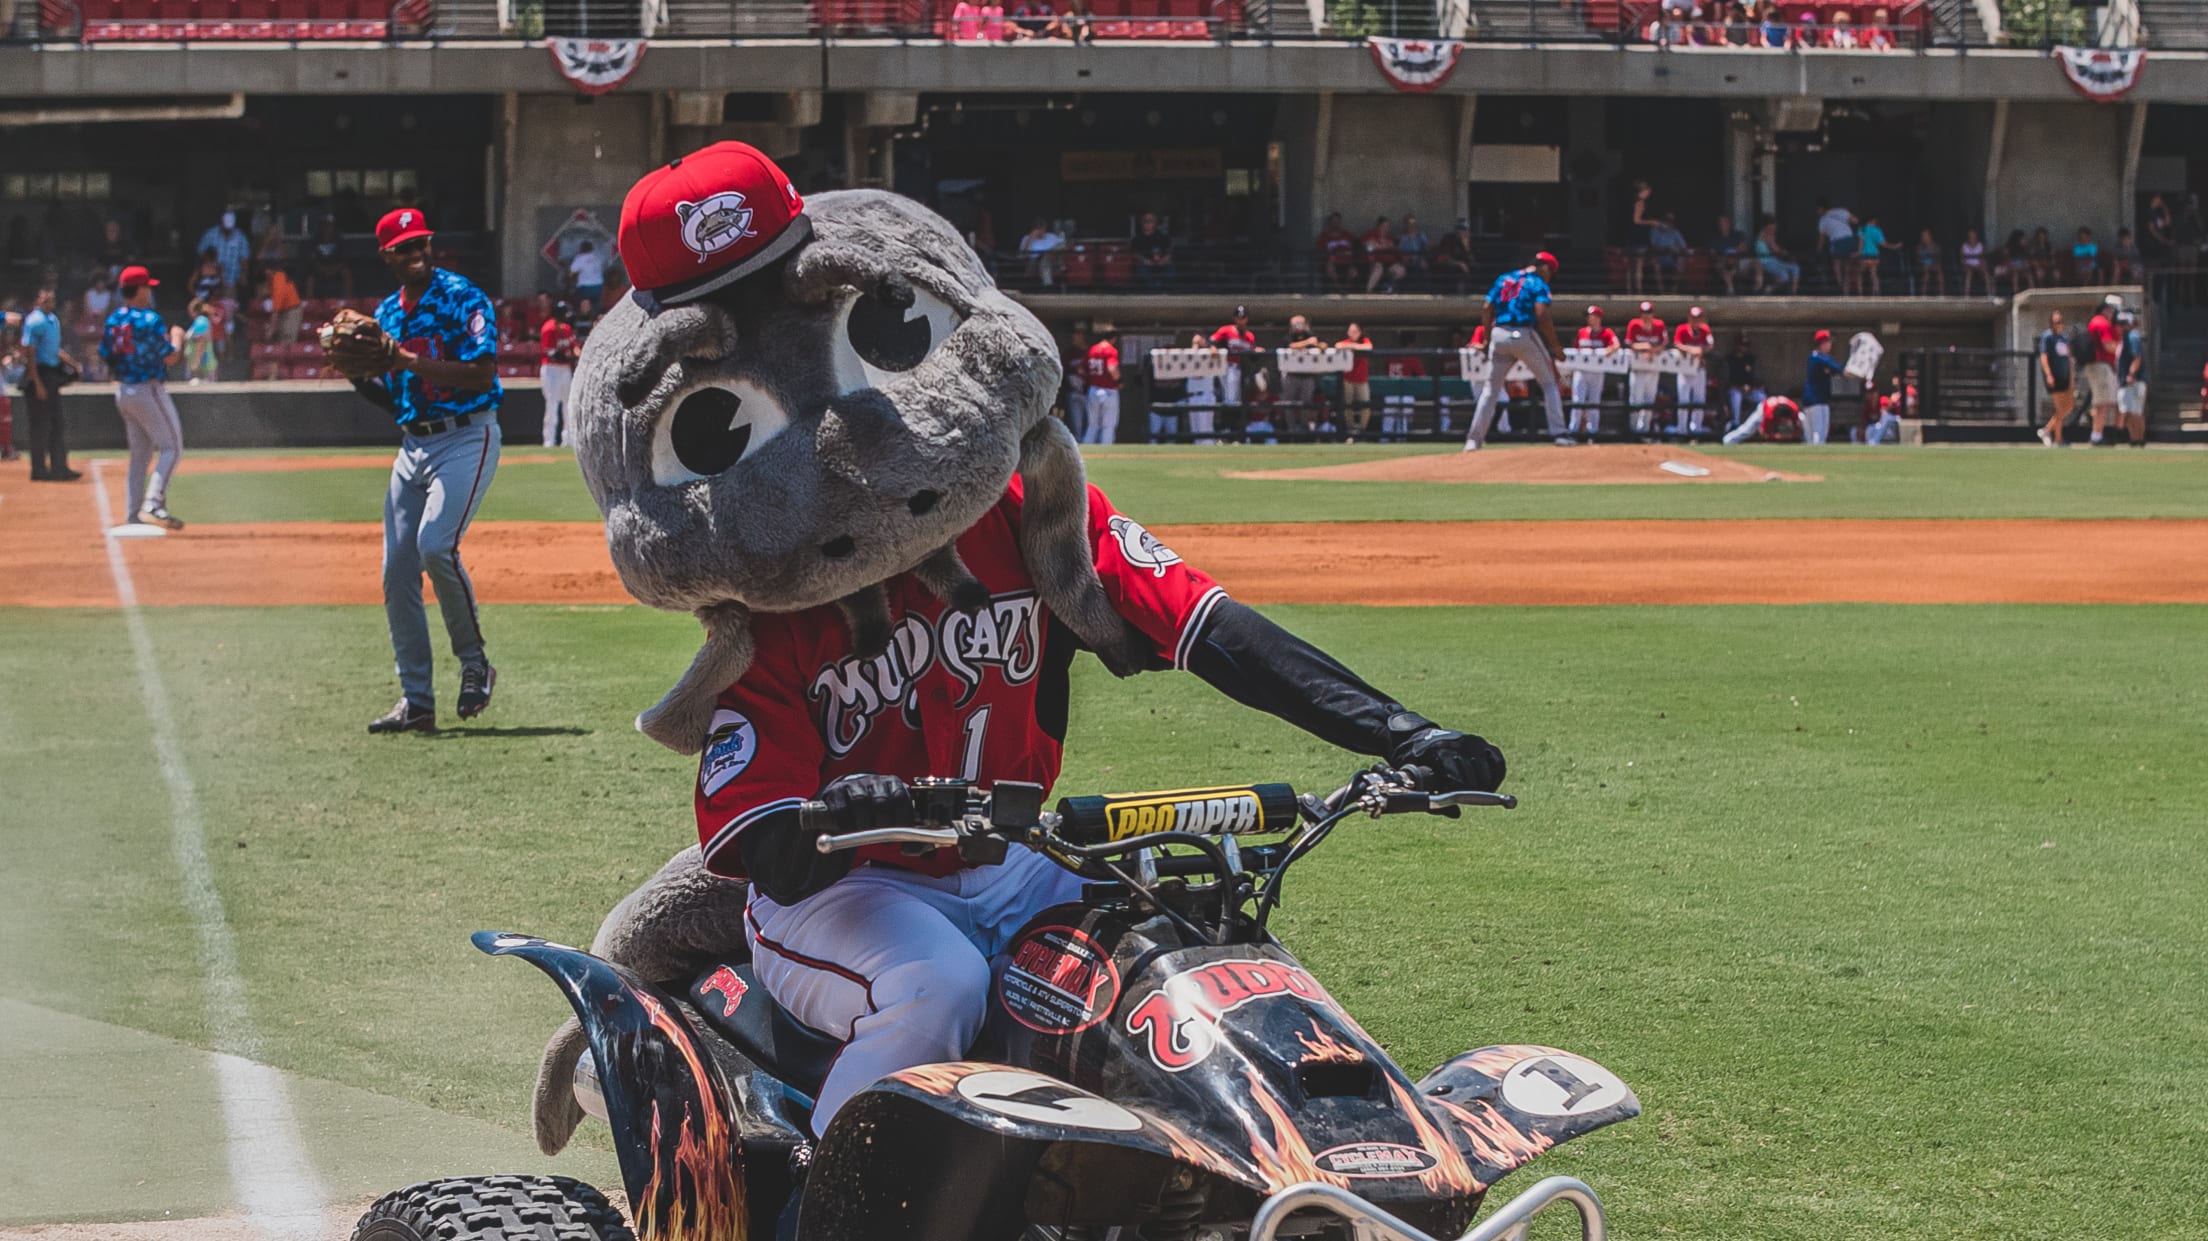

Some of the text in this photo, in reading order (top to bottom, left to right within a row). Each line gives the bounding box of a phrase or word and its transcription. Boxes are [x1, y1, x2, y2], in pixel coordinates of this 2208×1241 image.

[962, 703, 992, 783] 1
[1114, 797, 1259, 843] PROTAPER
[1012, 940, 1109, 1012] CYCLEMAX
[1519, 1058, 1603, 1111] 1
[1328, 1148, 1425, 1170] CYCLEMAX
